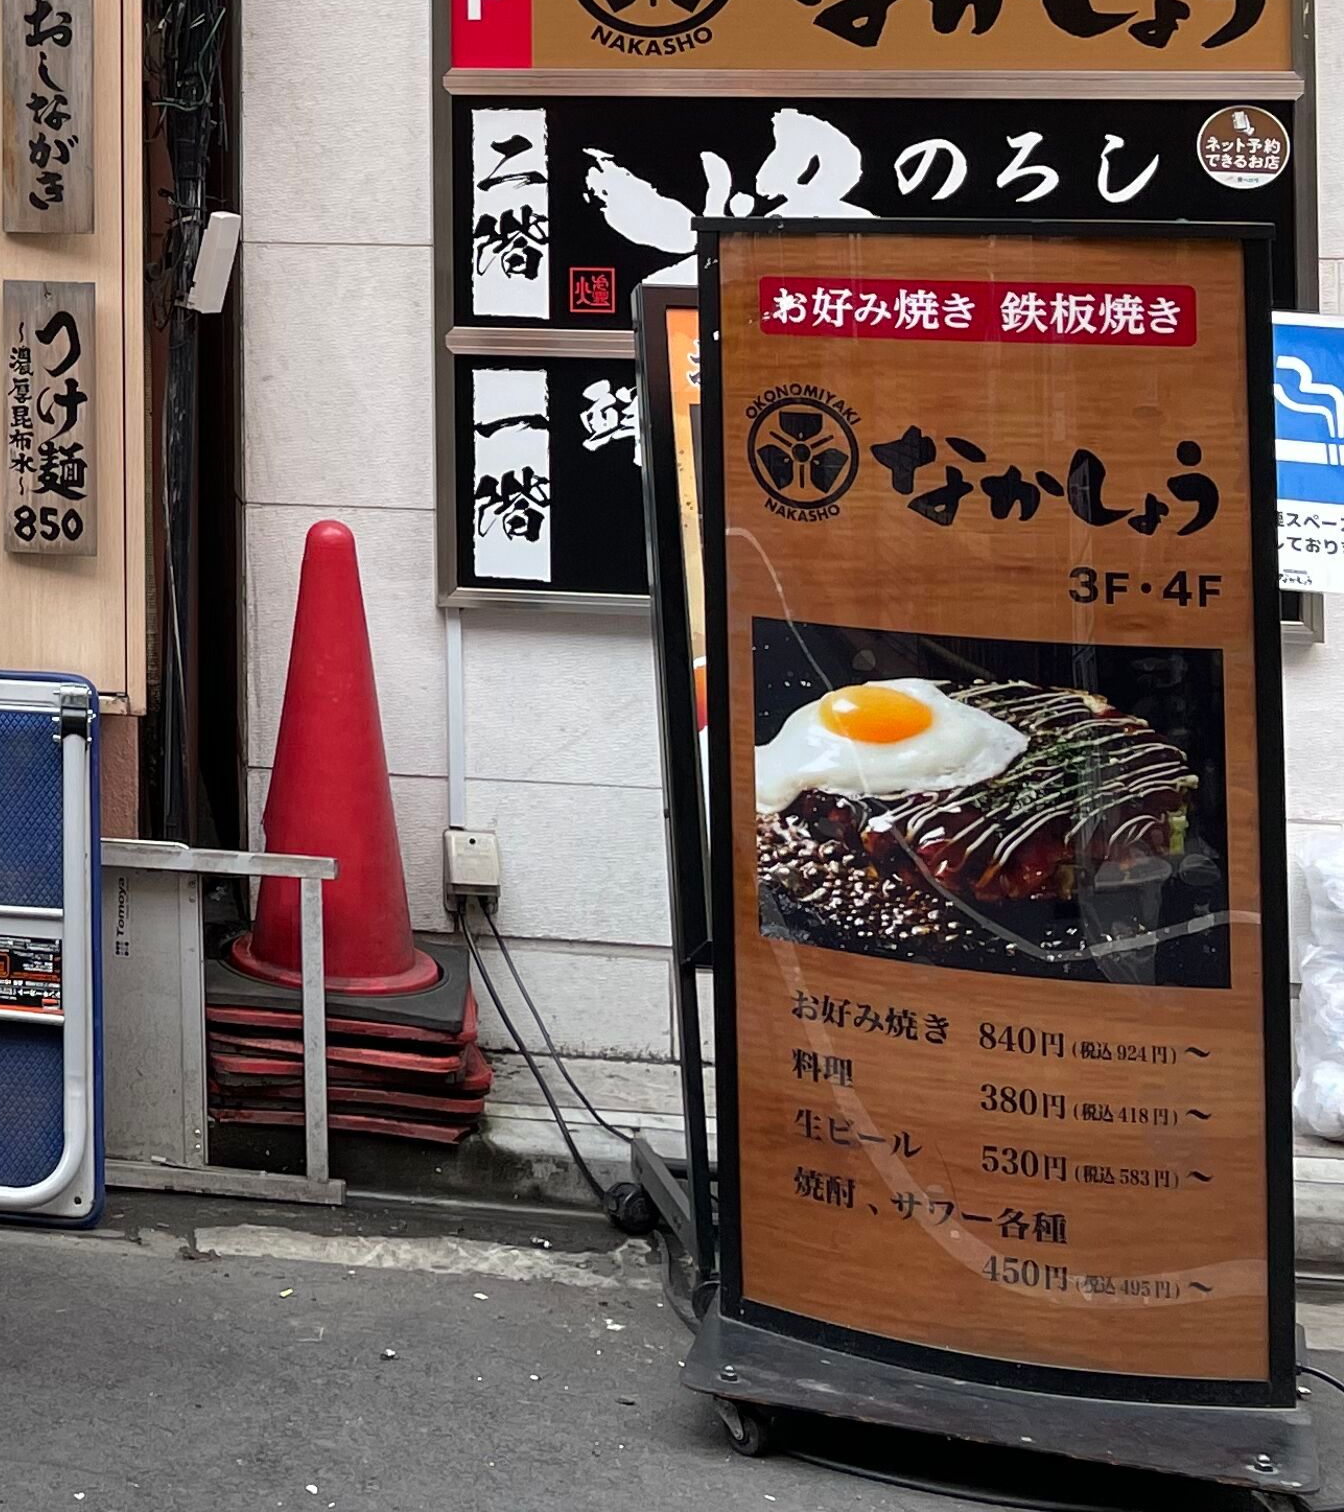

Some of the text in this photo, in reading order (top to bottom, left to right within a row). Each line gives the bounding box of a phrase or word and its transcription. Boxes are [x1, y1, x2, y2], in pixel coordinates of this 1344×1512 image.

[589, 24, 714, 59] NAKASHO
[893, 131, 1161, 206] のろし
[1203, 136, 1282, 154] ネット予約
[1203, 153, 1281, 170] できるお店
[476, 133, 549, 281] 二階
[771, 287, 1182, 336] お好み焼き 鉄板焼き
[31, 310, 89, 502] つけ麺
[745, 382, 862, 427] OKONOMIYAKI
[869, 425, 1219, 538] なかしょう
[13, 504, 84, 541] 850
[763, 497, 842, 524] NAKASHO
[115, 876, 128, 937] Tomoya
[790, 987, 952, 1045] お好み焼き
[790, 1047, 855, 1088] 料理
[794, 1108, 923, 1160] 生ビール
[793, 1166, 1069, 1245] 焼酎、サワー各種
